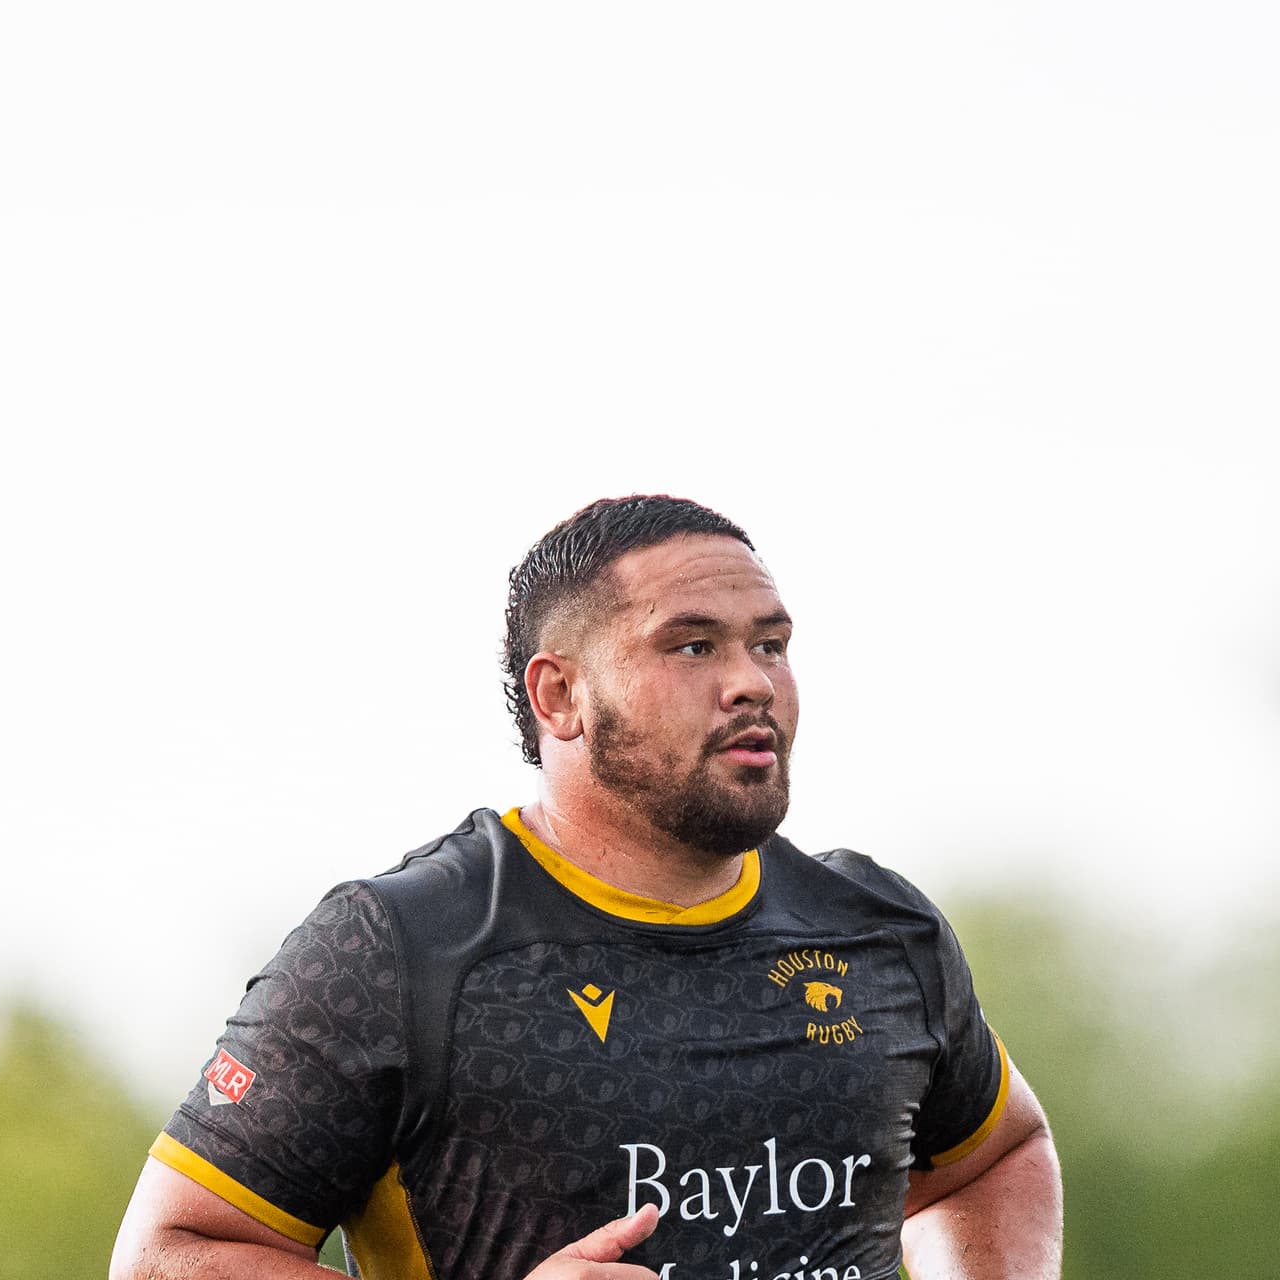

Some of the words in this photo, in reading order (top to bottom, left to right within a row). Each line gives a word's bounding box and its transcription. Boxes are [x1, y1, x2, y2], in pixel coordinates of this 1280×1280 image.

[767, 949, 849, 988] HOUSTON
[806, 1015, 863, 1045] RUGBY
[207, 1055, 247, 1097] MLR
[619, 1136, 872, 1238] Baylor
